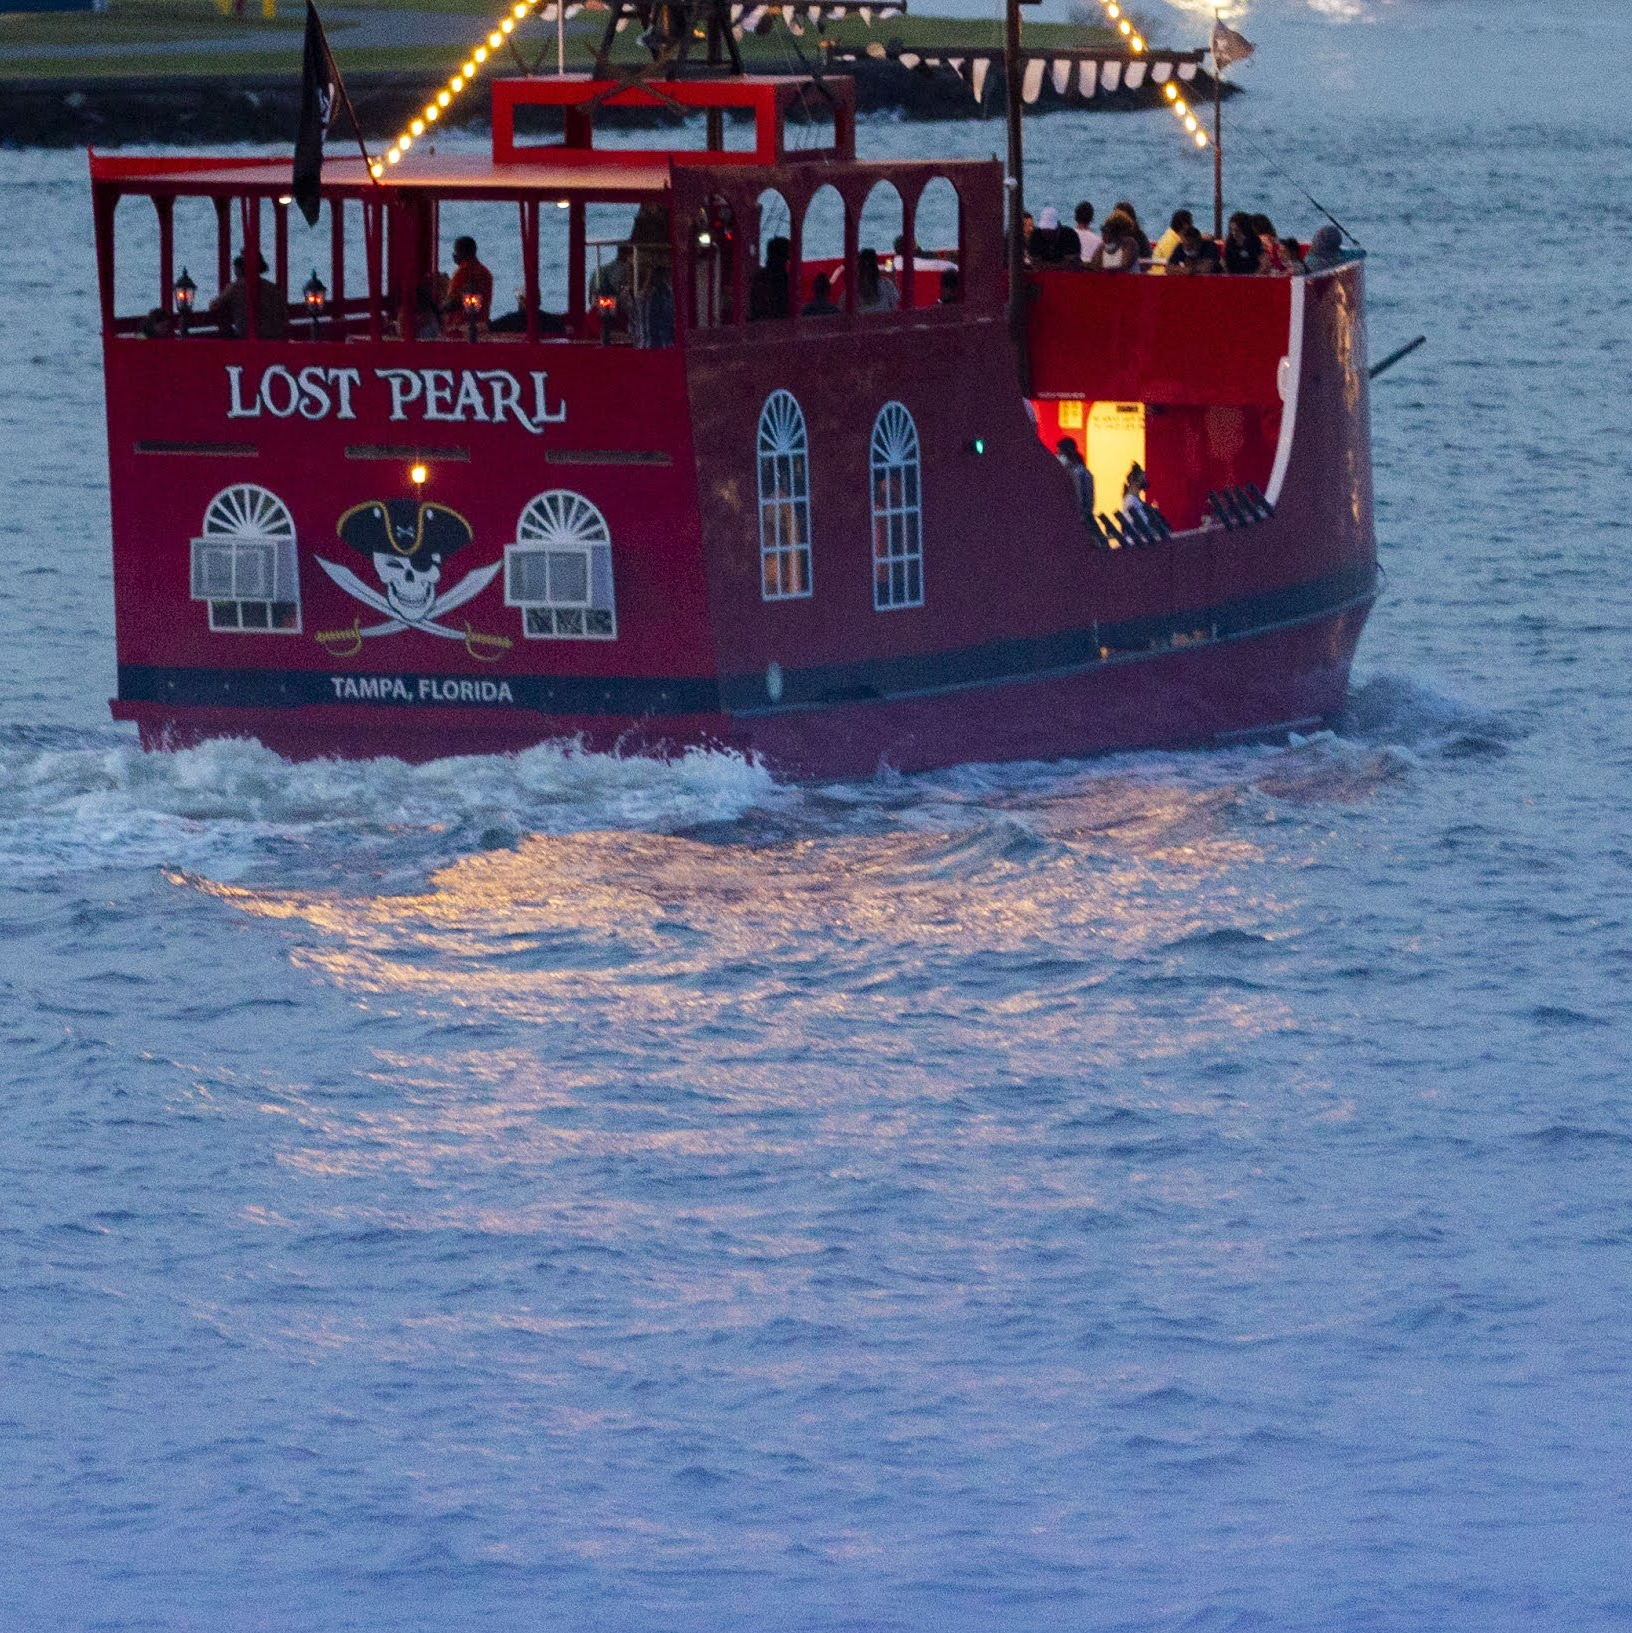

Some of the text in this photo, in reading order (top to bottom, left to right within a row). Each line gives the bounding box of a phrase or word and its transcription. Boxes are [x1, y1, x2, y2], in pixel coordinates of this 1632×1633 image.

[225, 364, 566, 434] LOST PEARL
[330, 676, 514, 703] TAMPA, FLORIDA
